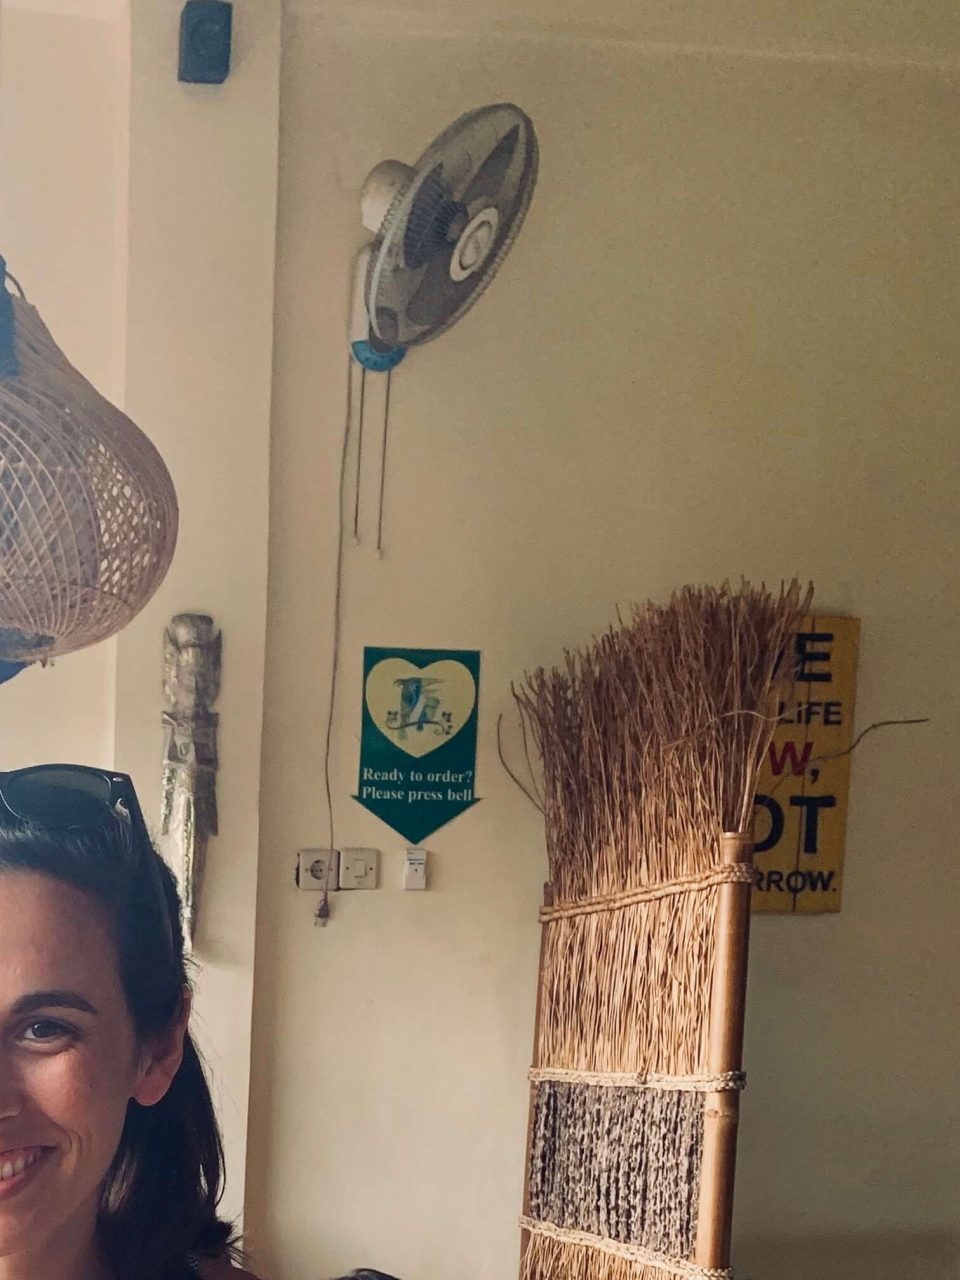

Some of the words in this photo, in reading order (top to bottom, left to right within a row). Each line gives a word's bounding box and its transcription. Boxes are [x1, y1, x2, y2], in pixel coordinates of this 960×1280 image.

[778, 702, 842, 725] LIFE
[363, 767, 404, 784] Ready
[410, 770, 423, 782] to
[427, 769, 473, 783] order?
[362, 786, 405, 800] Please
[408, 789, 443, 804] press
[447, 788, 472, 801] bell
